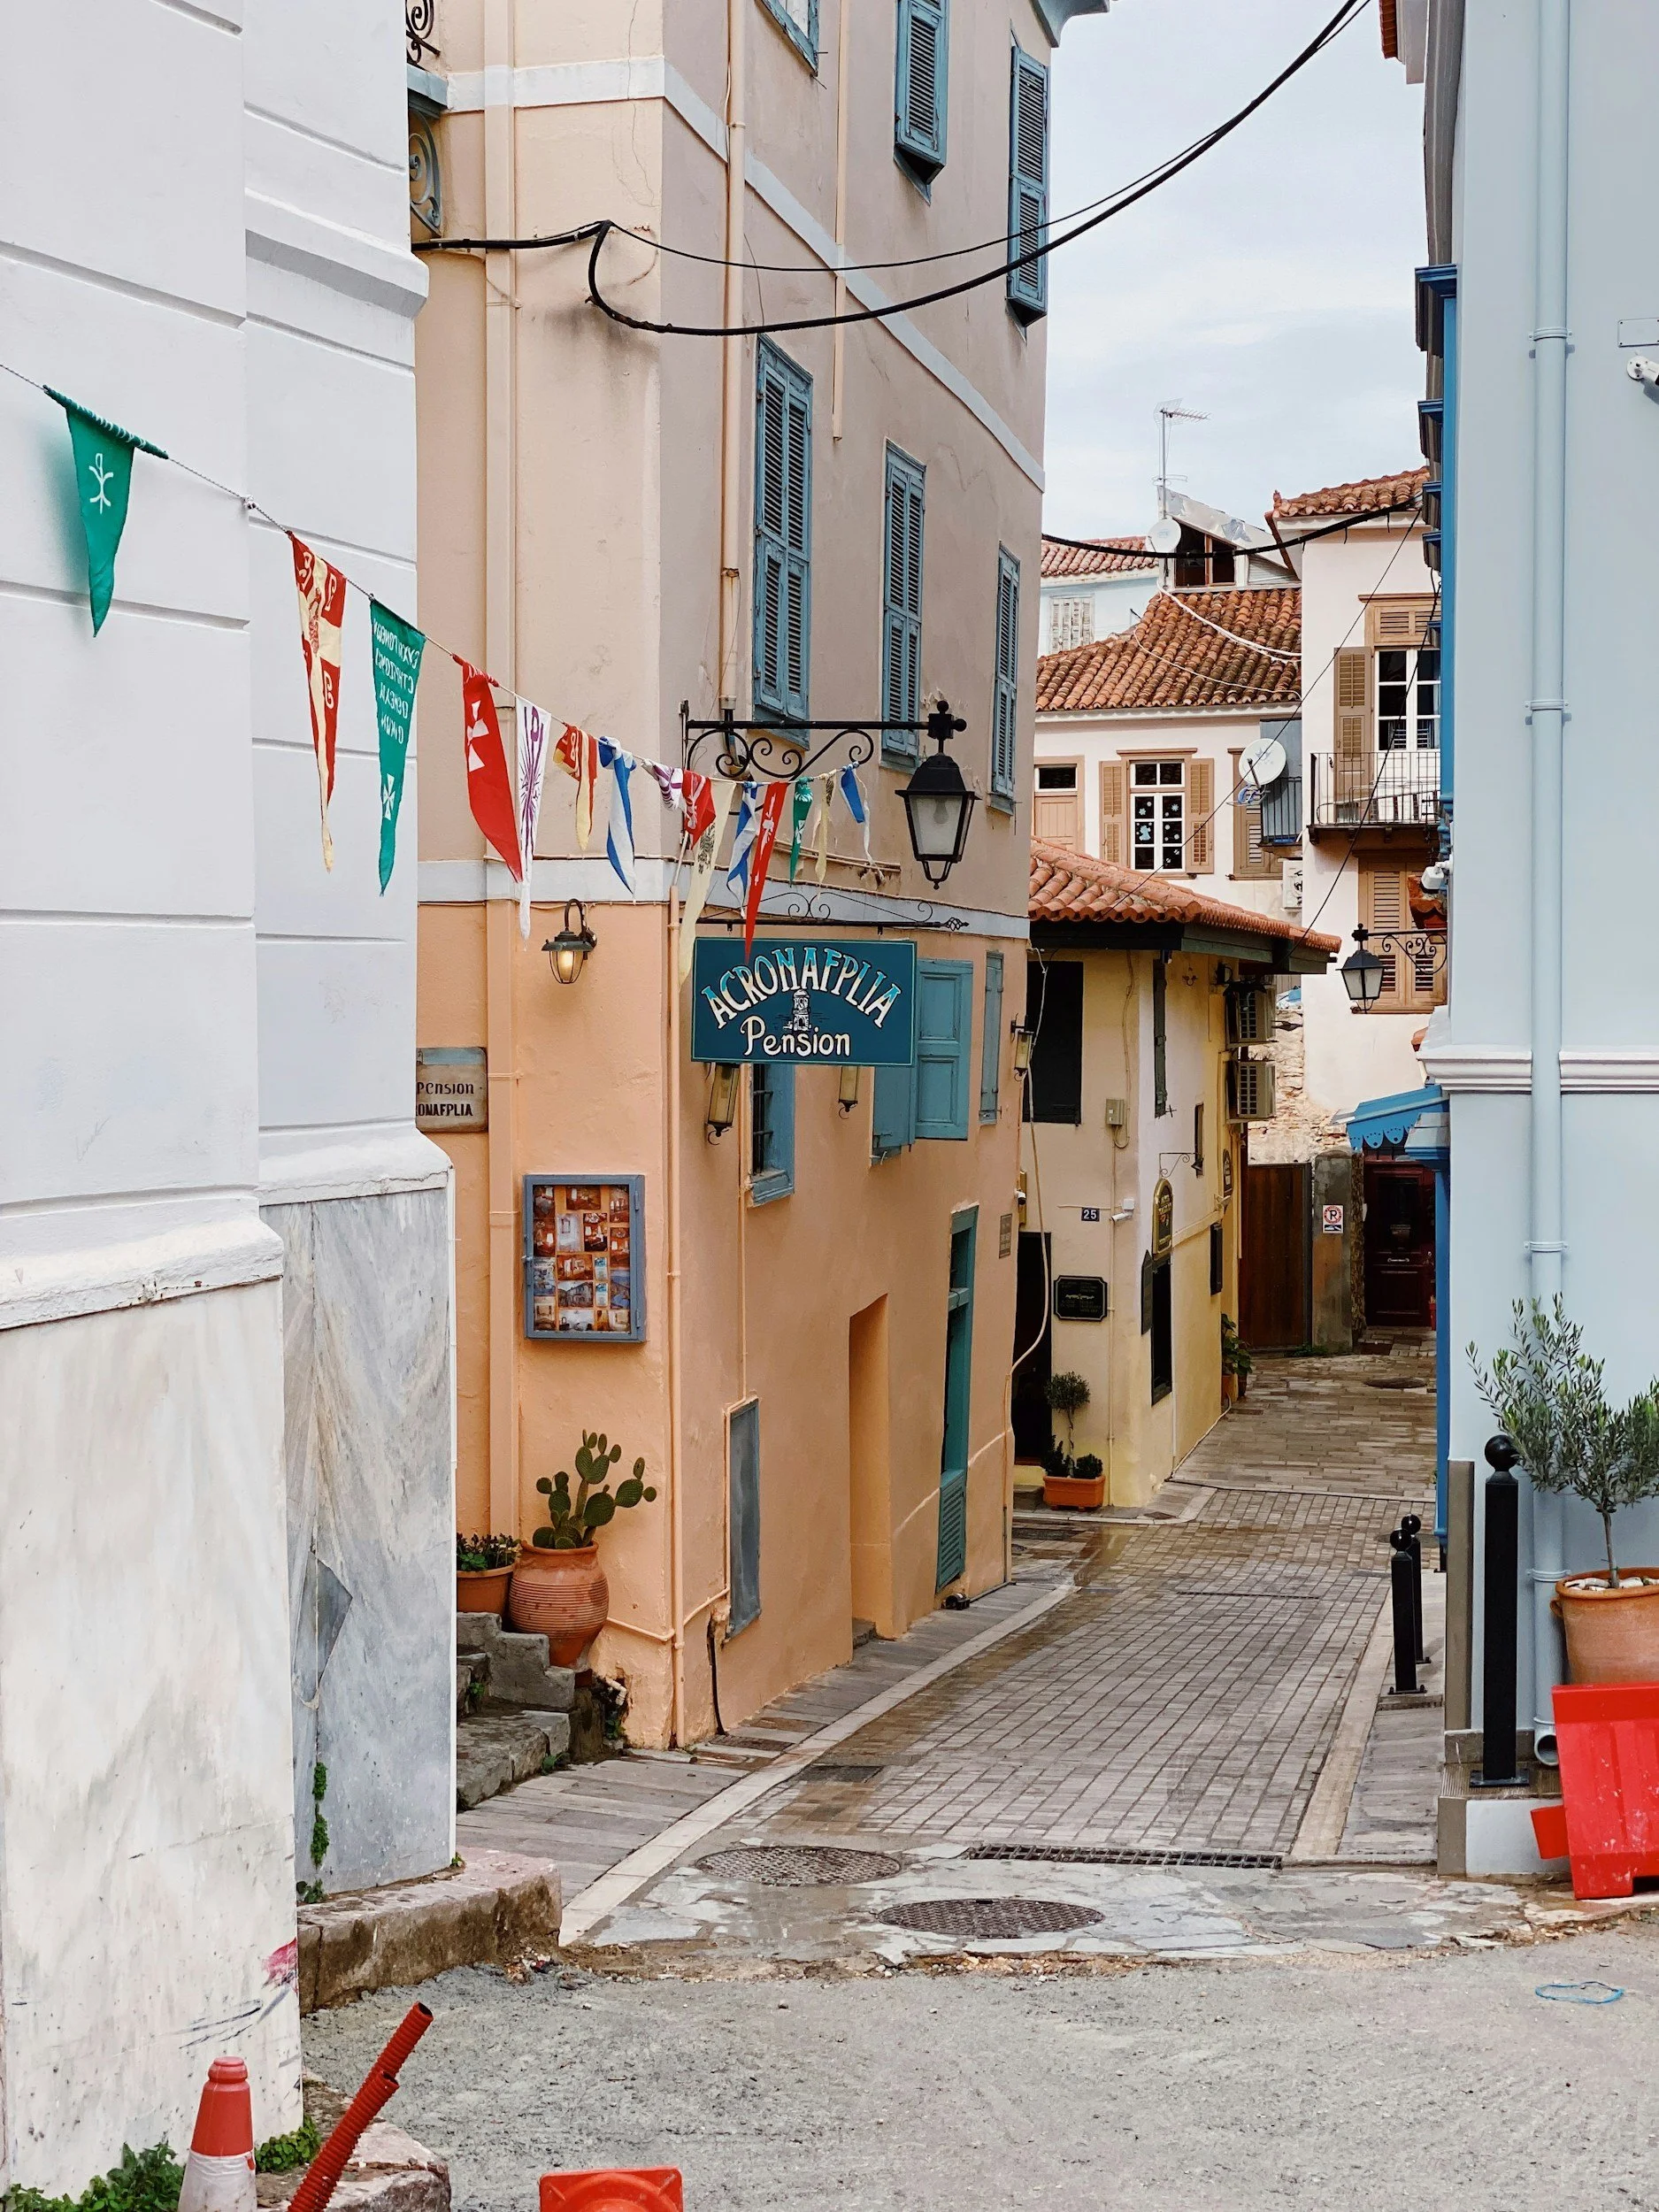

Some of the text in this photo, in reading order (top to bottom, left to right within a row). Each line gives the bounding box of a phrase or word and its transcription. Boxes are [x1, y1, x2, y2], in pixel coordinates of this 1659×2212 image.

[701, 947, 902, 1029] ACRONAFPLIA
[740, 1015, 851, 1056] Pension
[416, 1103, 473, 1117] ONAFPLIA
[1083, 1210, 1097, 1220] 25
